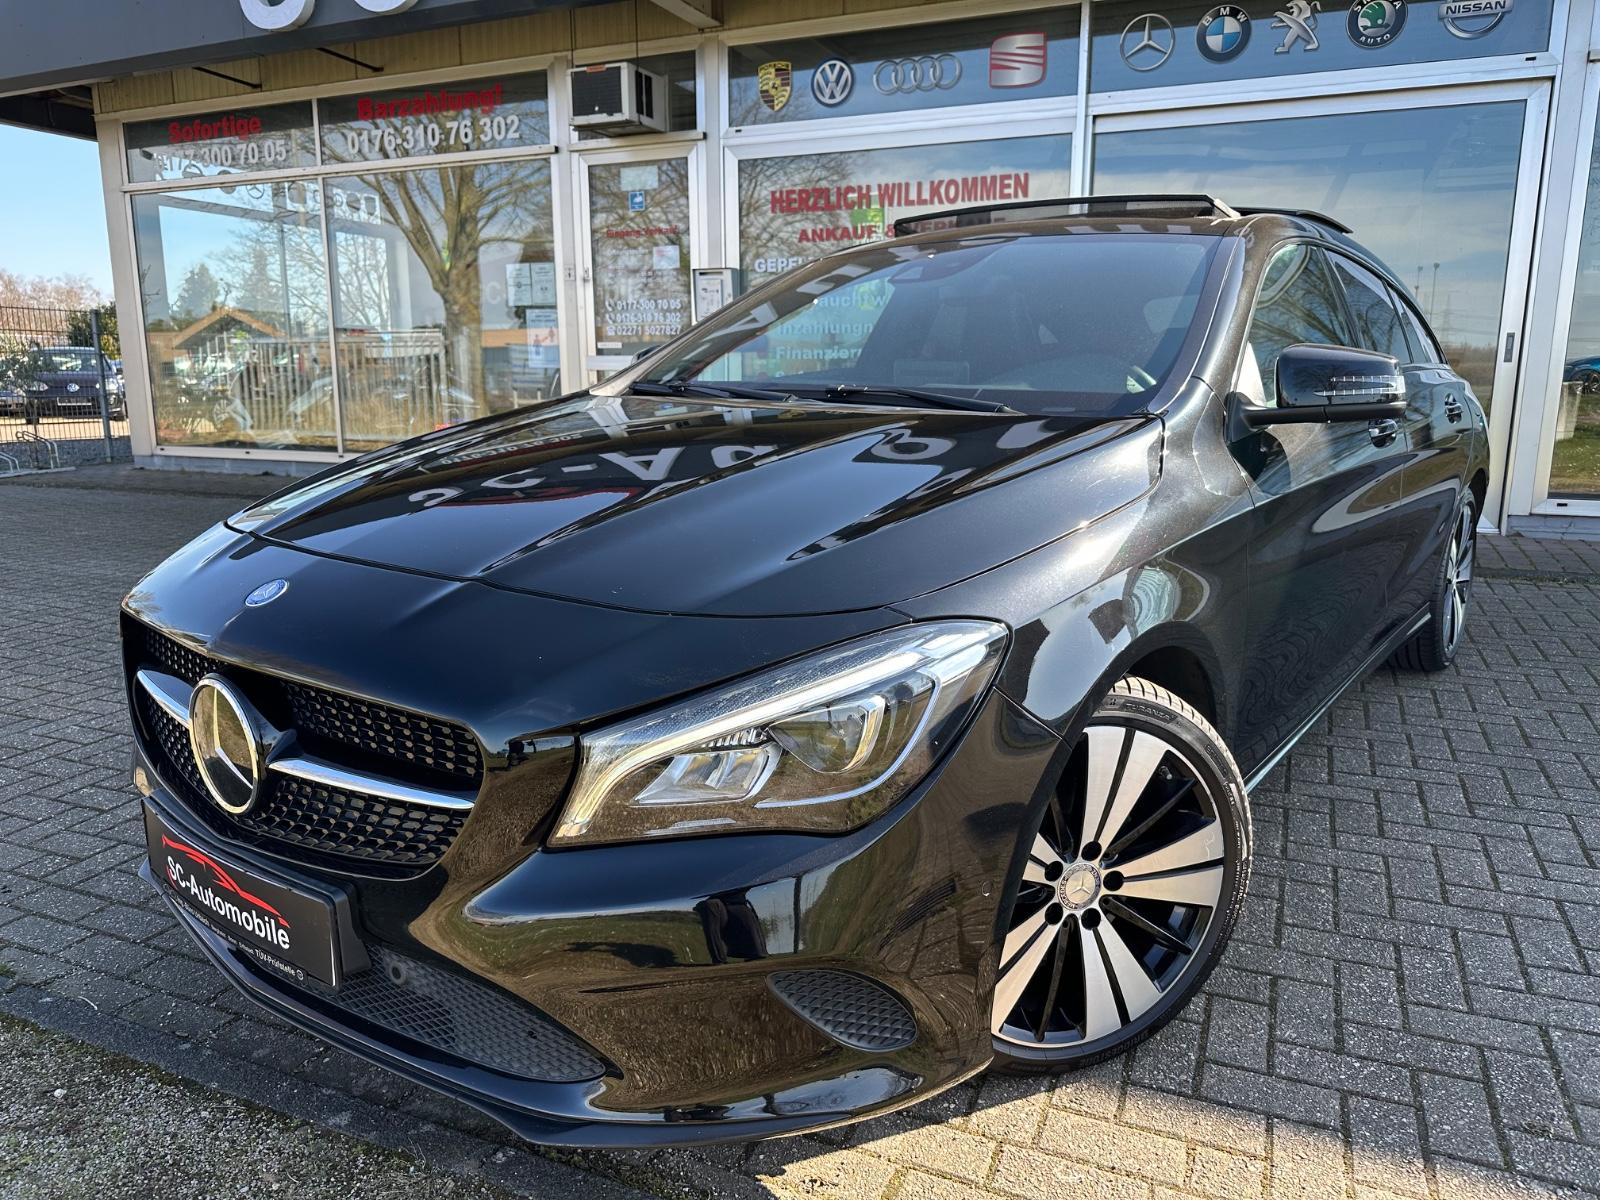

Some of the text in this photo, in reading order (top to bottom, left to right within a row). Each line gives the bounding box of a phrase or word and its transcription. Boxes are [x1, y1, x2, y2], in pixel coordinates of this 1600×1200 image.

[1202, 6, 1248, 26] BMW
[1445, 1, 1506, 15] NISSAN
[1360, 33, 1391, 43] AUTO
[356, 84, 504, 122] Barzahlung!
[168, 115, 261, 144] Sofortige
[347, 114, 520, 154] 0176-310 76 302
[237, 143, 259, 165] 70
[263, 140, 287, 161] 05
[770, 172, 1030, 214] HERZLICH WILLKOMMEN
[798, 224, 876, 243] ANKAUF
[167, 855, 290, 950] SC-Automobile
